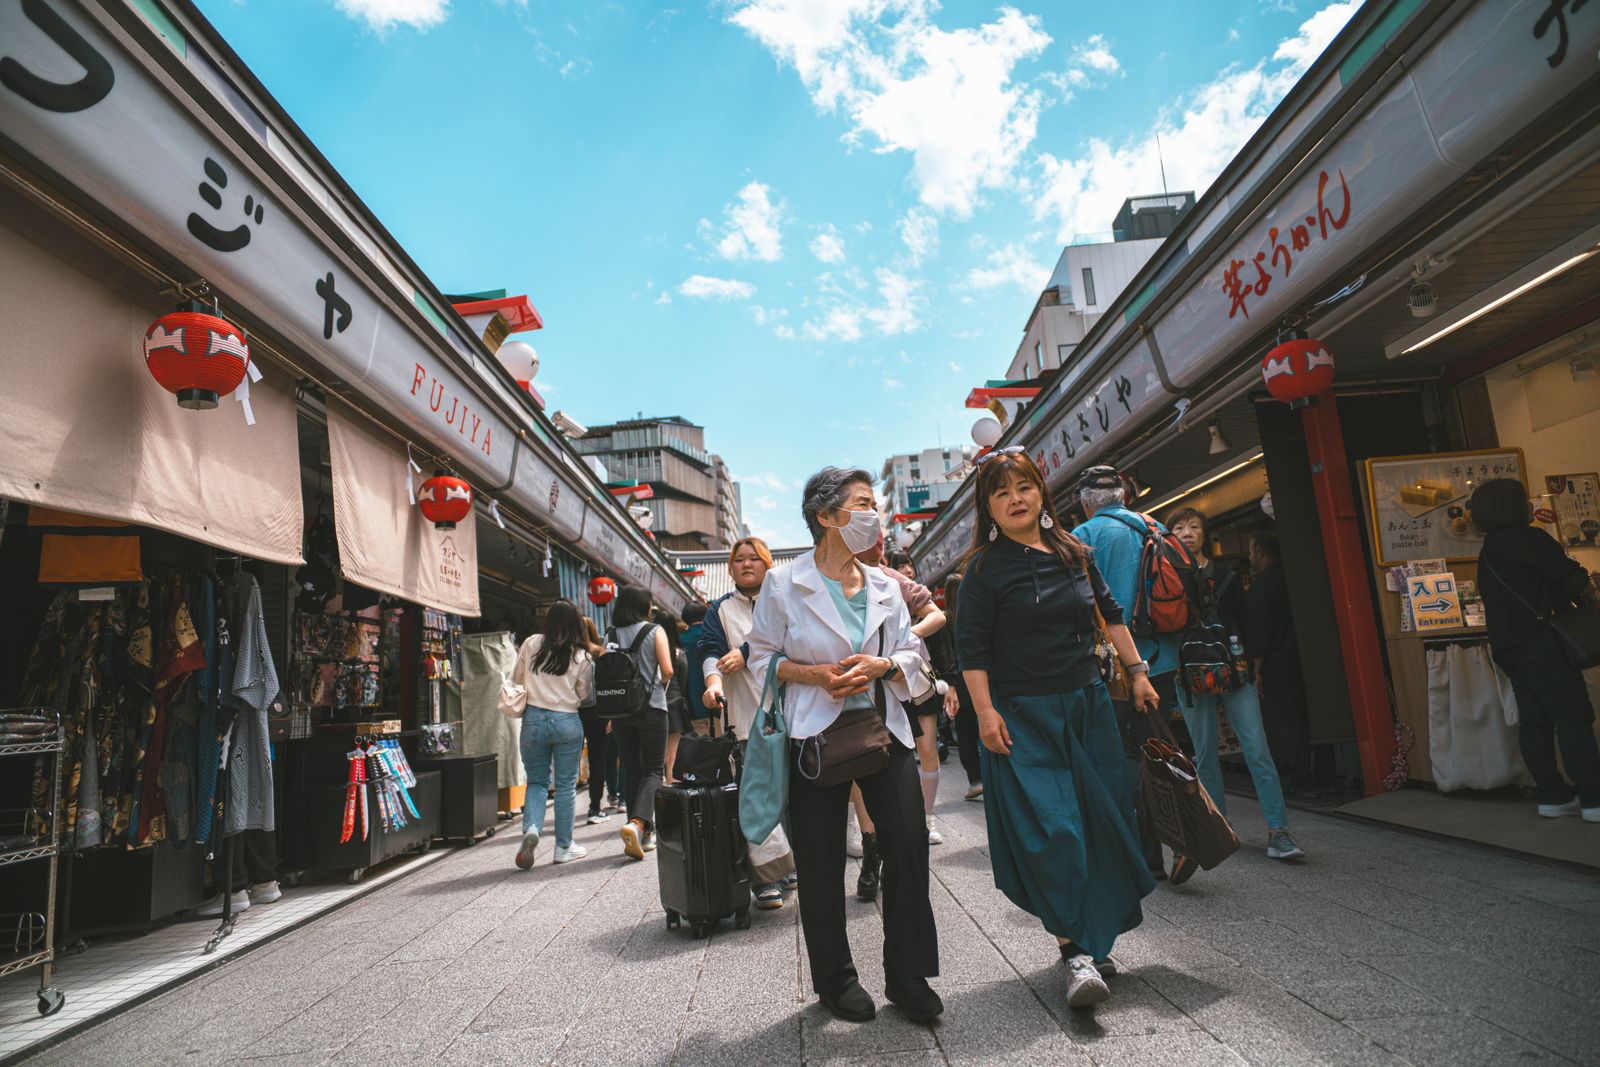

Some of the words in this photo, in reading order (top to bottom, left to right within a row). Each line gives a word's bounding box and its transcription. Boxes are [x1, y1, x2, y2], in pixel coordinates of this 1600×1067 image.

[410, 362, 491, 456] FUJIYA
[1399, 533, 1419, 542] Bean
[1392, 541, 1413, 550] paste
[1412, 580, 1454, 597] 入口
[1418, 617, 1460, 626] Entrance
